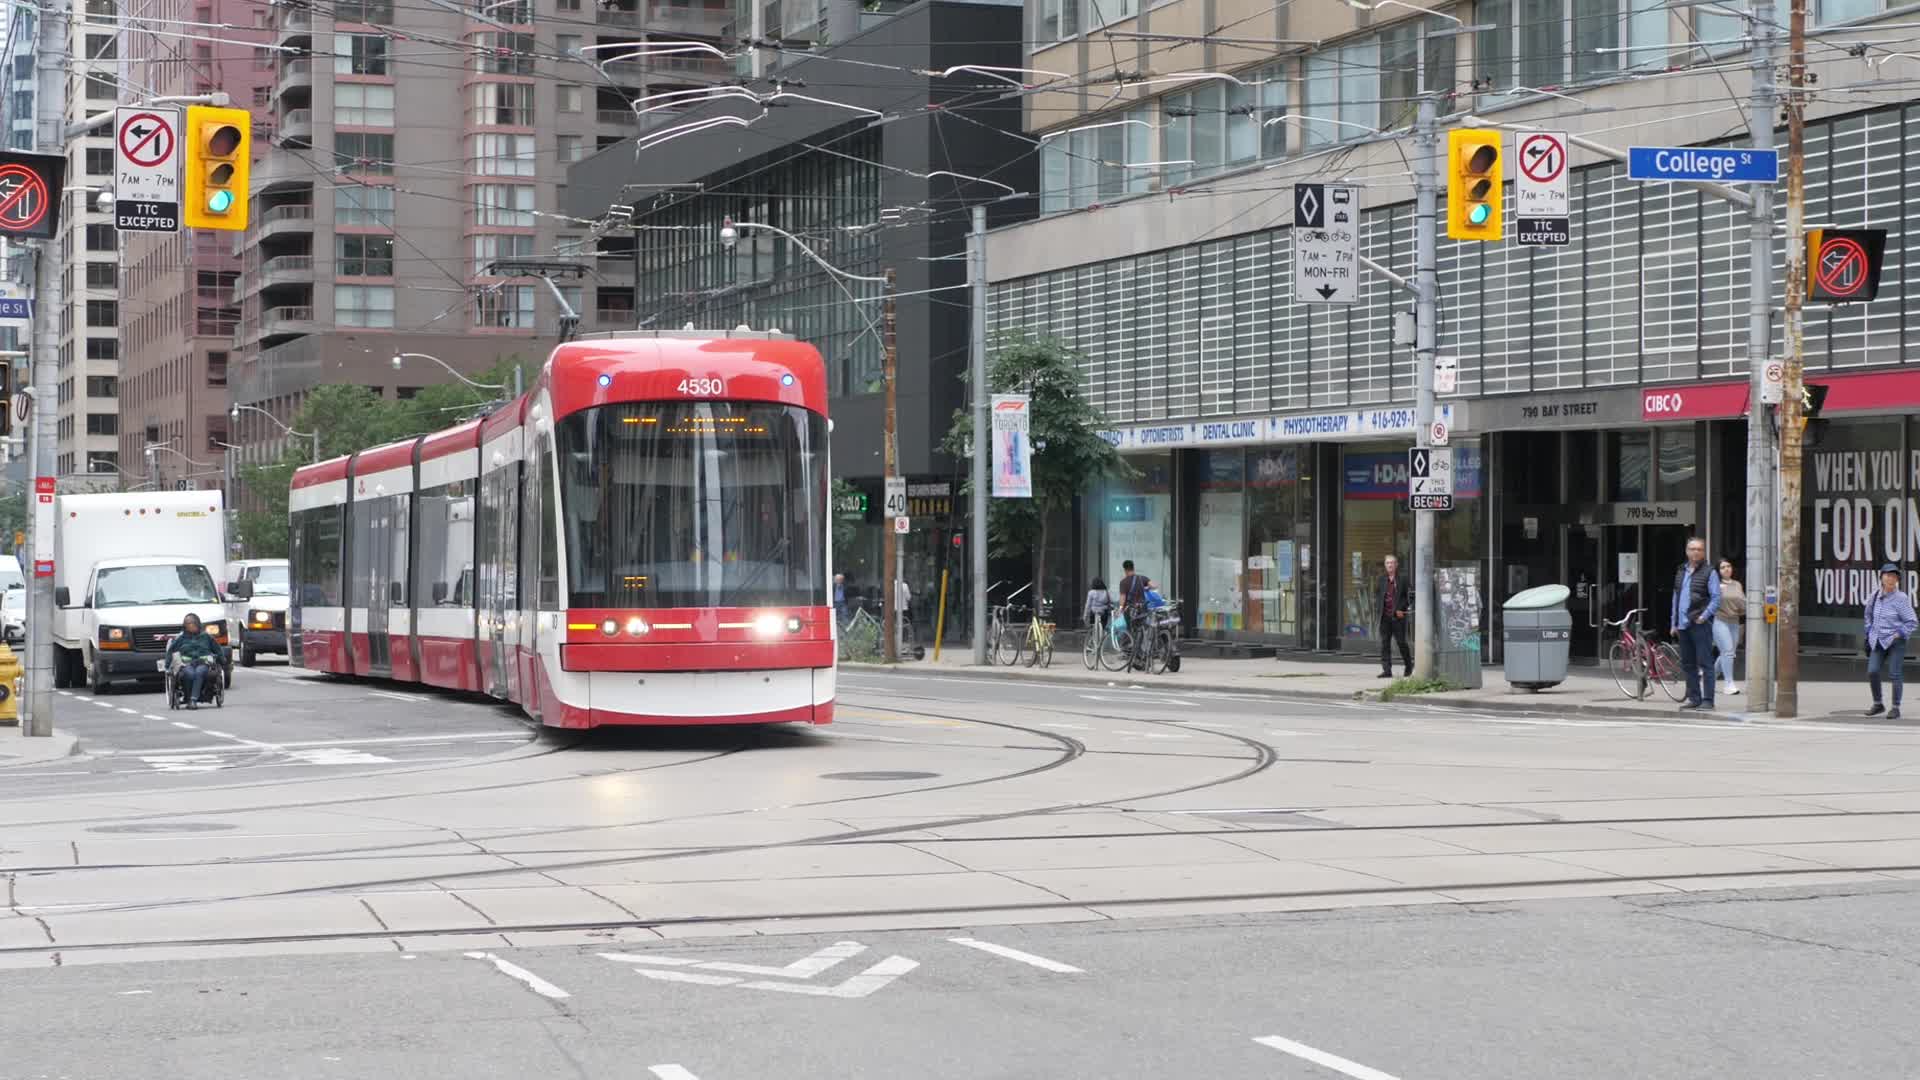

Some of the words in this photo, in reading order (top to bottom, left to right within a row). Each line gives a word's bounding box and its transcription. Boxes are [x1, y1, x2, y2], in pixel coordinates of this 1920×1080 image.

[1655, 151, 1736, 179] College
[1740, 152, 1752, 165] St
[121, 173, 140, 184] 7AM
[155, 174, 174, 186] 7PM
[1520, 189, 1536, 201] 7AM
[136, 203, 158, 215] TTC
[119, 216, 175, 228] EXCEPTED
[1533, 221, 1553, 231] TTC
[1520, 232, 1567, 242] EXCEPTED
[1301, 249, 1319, 262] 7AM
[1304, 266, 1349, 278] MON-FRI
[677, 378, 722, 395] 4530
[1522, 406, 1538, 418] 790
[1542, 404, 1559, 417] BAY
[1563, 402, 1597, 416] STREET
[1645, 395, 1670, 412] CIBC
[1283, 415, 1349, 435] PHYSIOTHERAPY
[1372, 410, 1415, 429] 416-929-1
[1140, 427, 1184, 443] OPTOMETRISTS
[1202, 423, 1230, 440] DENTAL
[1232, 421, 1256, 438] CLINIC
[1814, 452, 1867, 492] WHEN
[1870, 450, 1901, 492] YOU
[1429, 486, 1446, 494] LANE
[888, 494, 904, 512] 40
[1413, 495, 1449, 508] BEGINS
[1626, 506, 1640, 518] 790
[1642, 506, 1655, 520] Bay
[1656, 506, 1678, 518] Street
[1814, 497, 1873, 562] FOR
[1814, 567, 1845, 606] YOU
